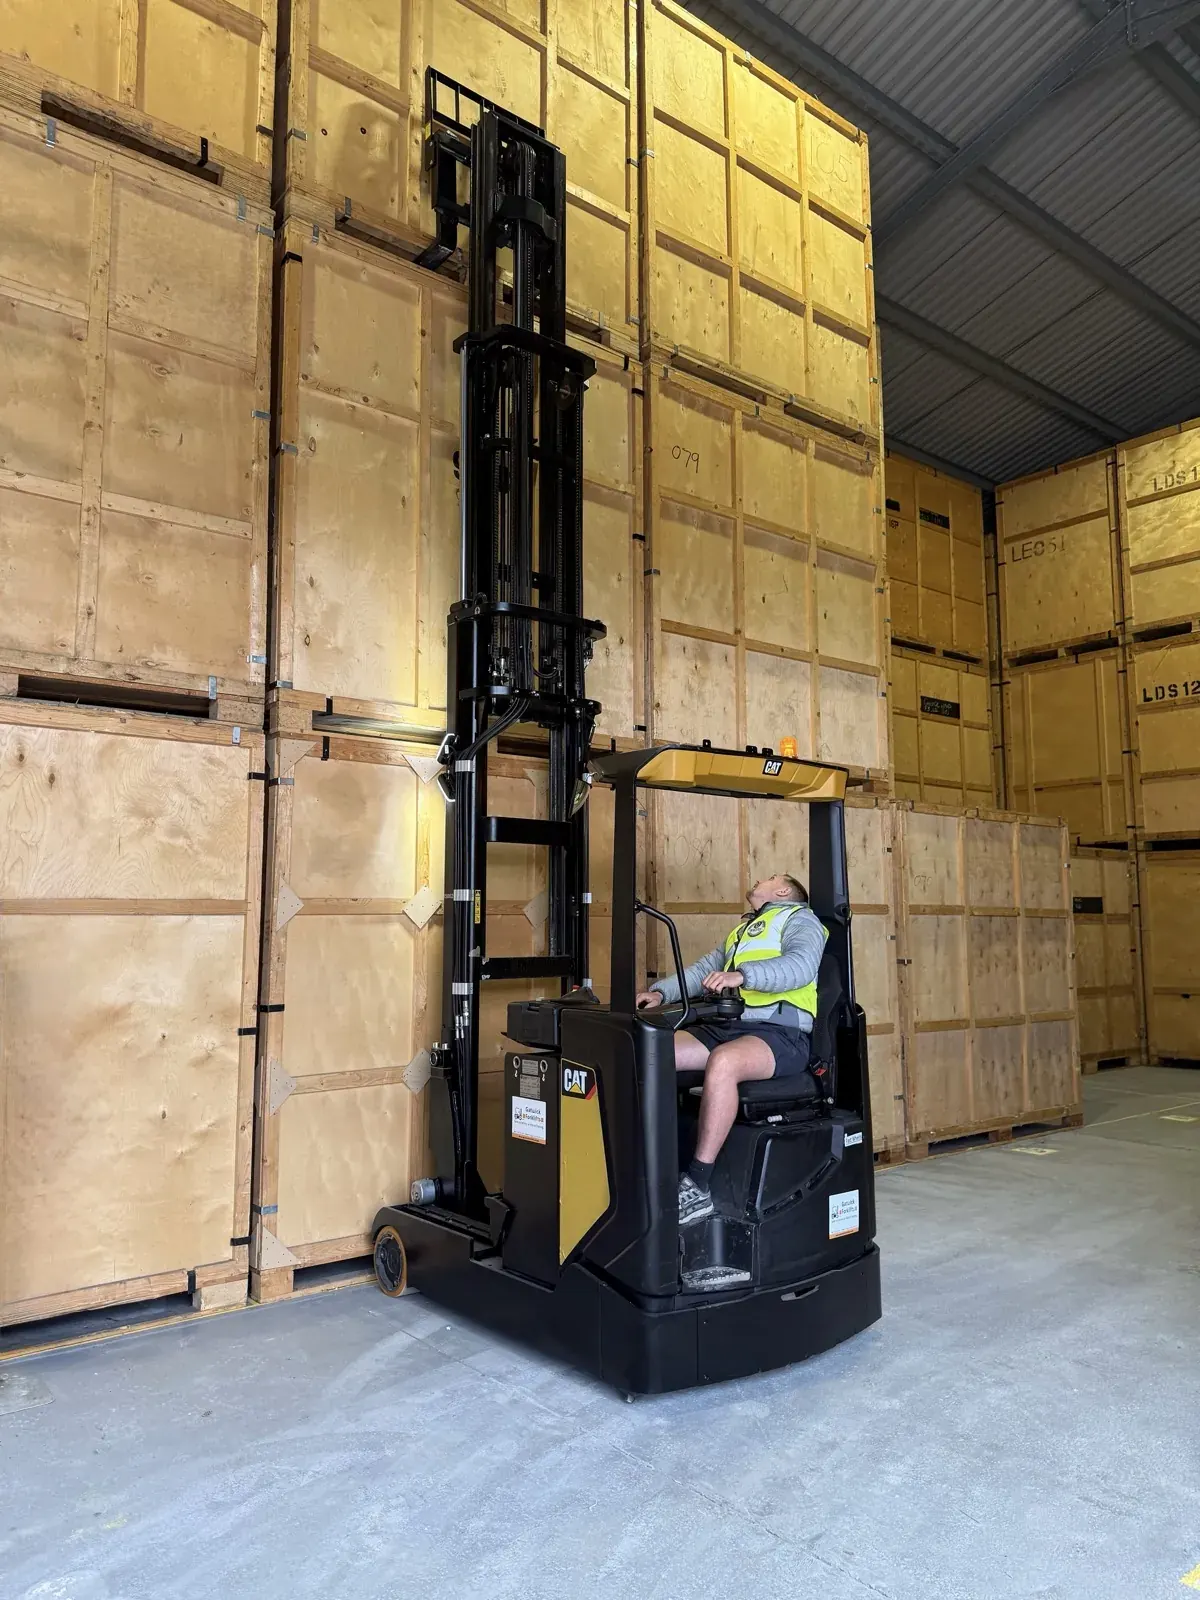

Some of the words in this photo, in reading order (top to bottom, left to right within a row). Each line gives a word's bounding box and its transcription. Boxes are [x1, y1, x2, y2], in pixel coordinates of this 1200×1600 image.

[671, 444, 700, 474] 079
[1152, 470, 1187, 492] LDS
[1142, 683, 1179, 703] LDS
[764, 760, 782, 774] CAT
[564, 1069, 588, 1094] CAT
